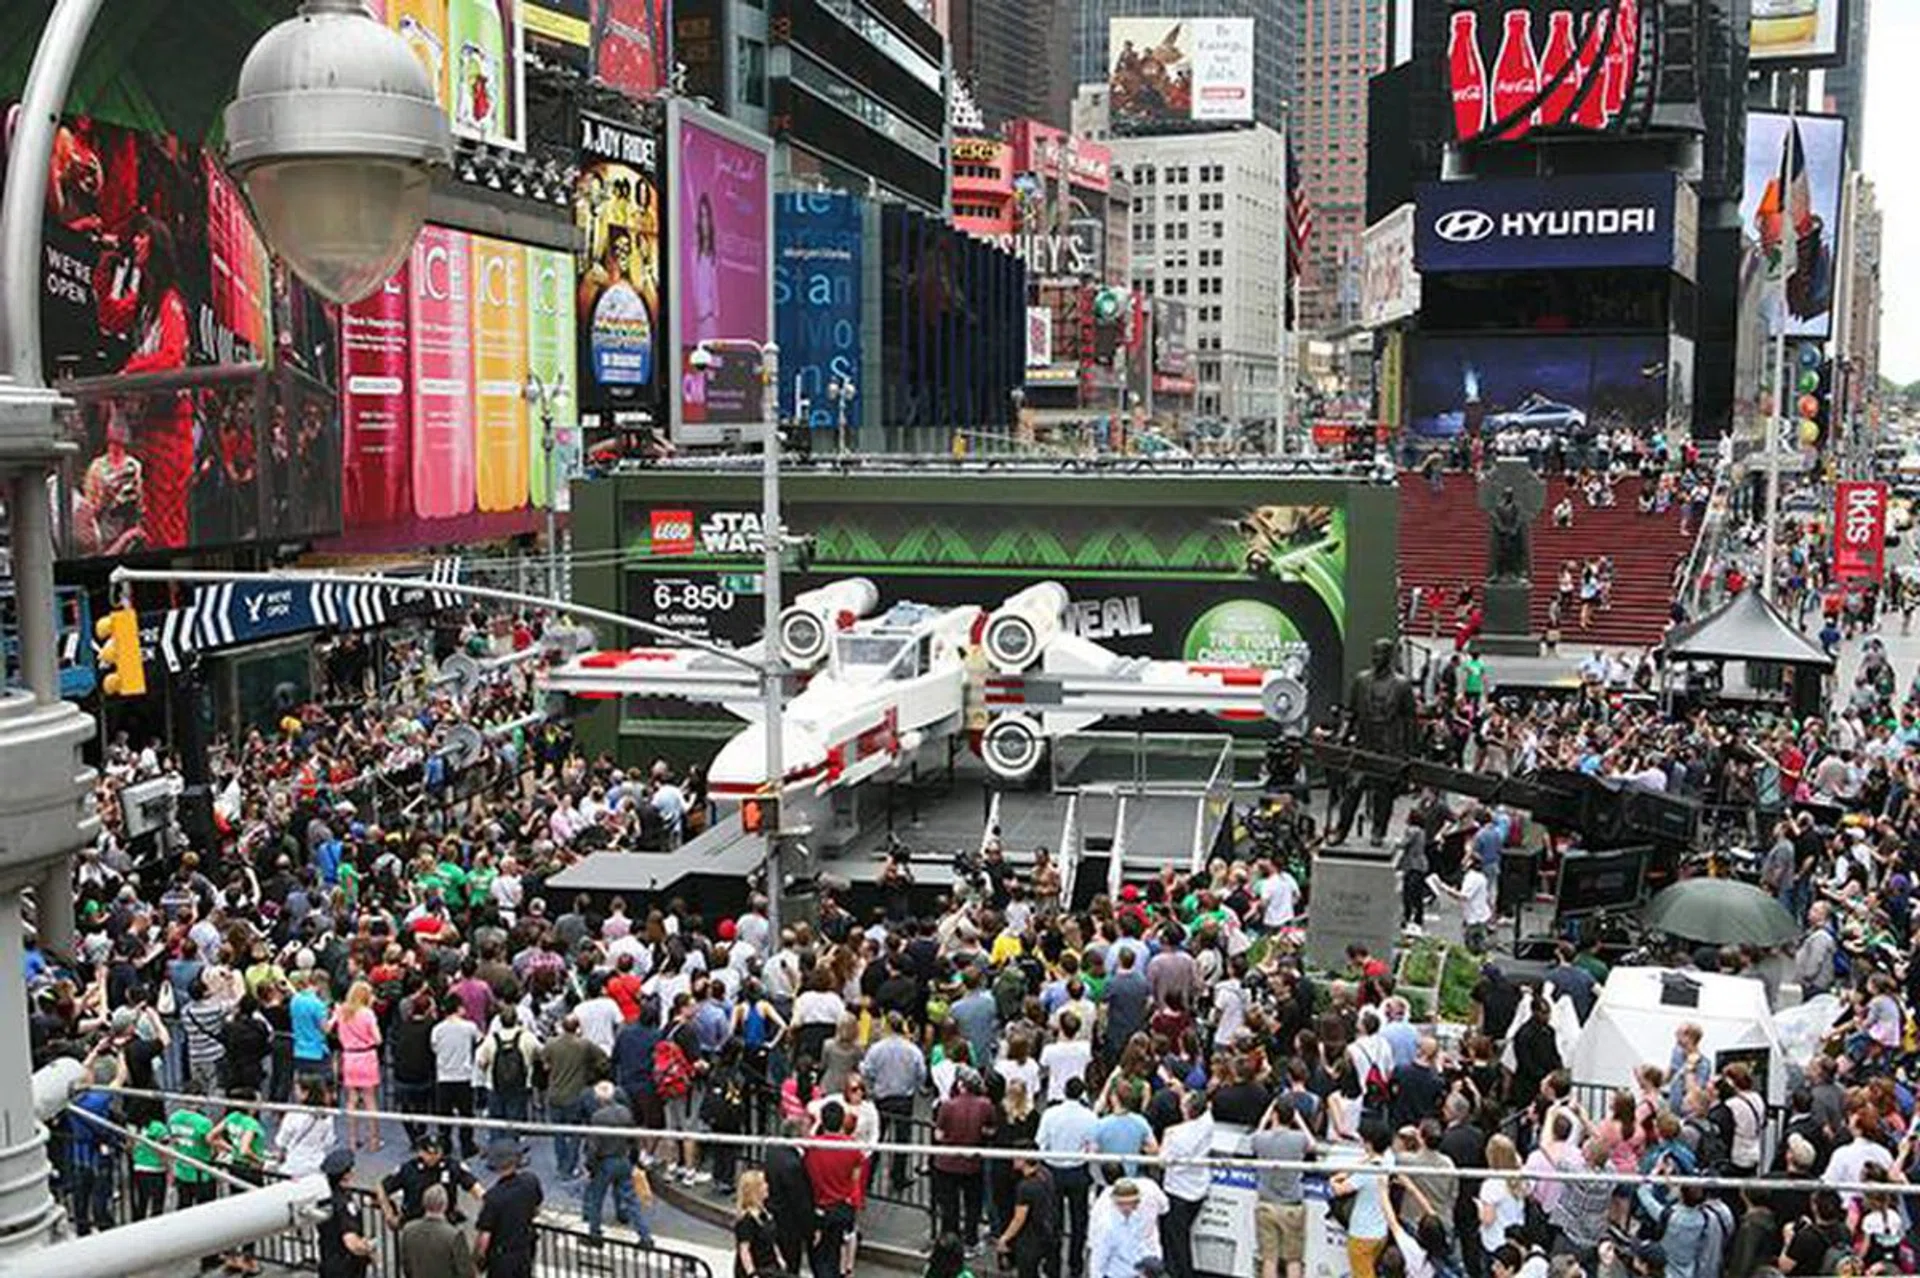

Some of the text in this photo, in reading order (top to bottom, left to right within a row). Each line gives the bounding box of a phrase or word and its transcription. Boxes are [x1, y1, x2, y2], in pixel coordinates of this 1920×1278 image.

[1501, 207, 1656, 237] HYUNDAI
[46, 245, 91, 284] WE'RE
[47, 273, 87, 304] OPEN
[655, 522, 692, 540] LEGO
[1845, 487, 1880, 544] tkts
